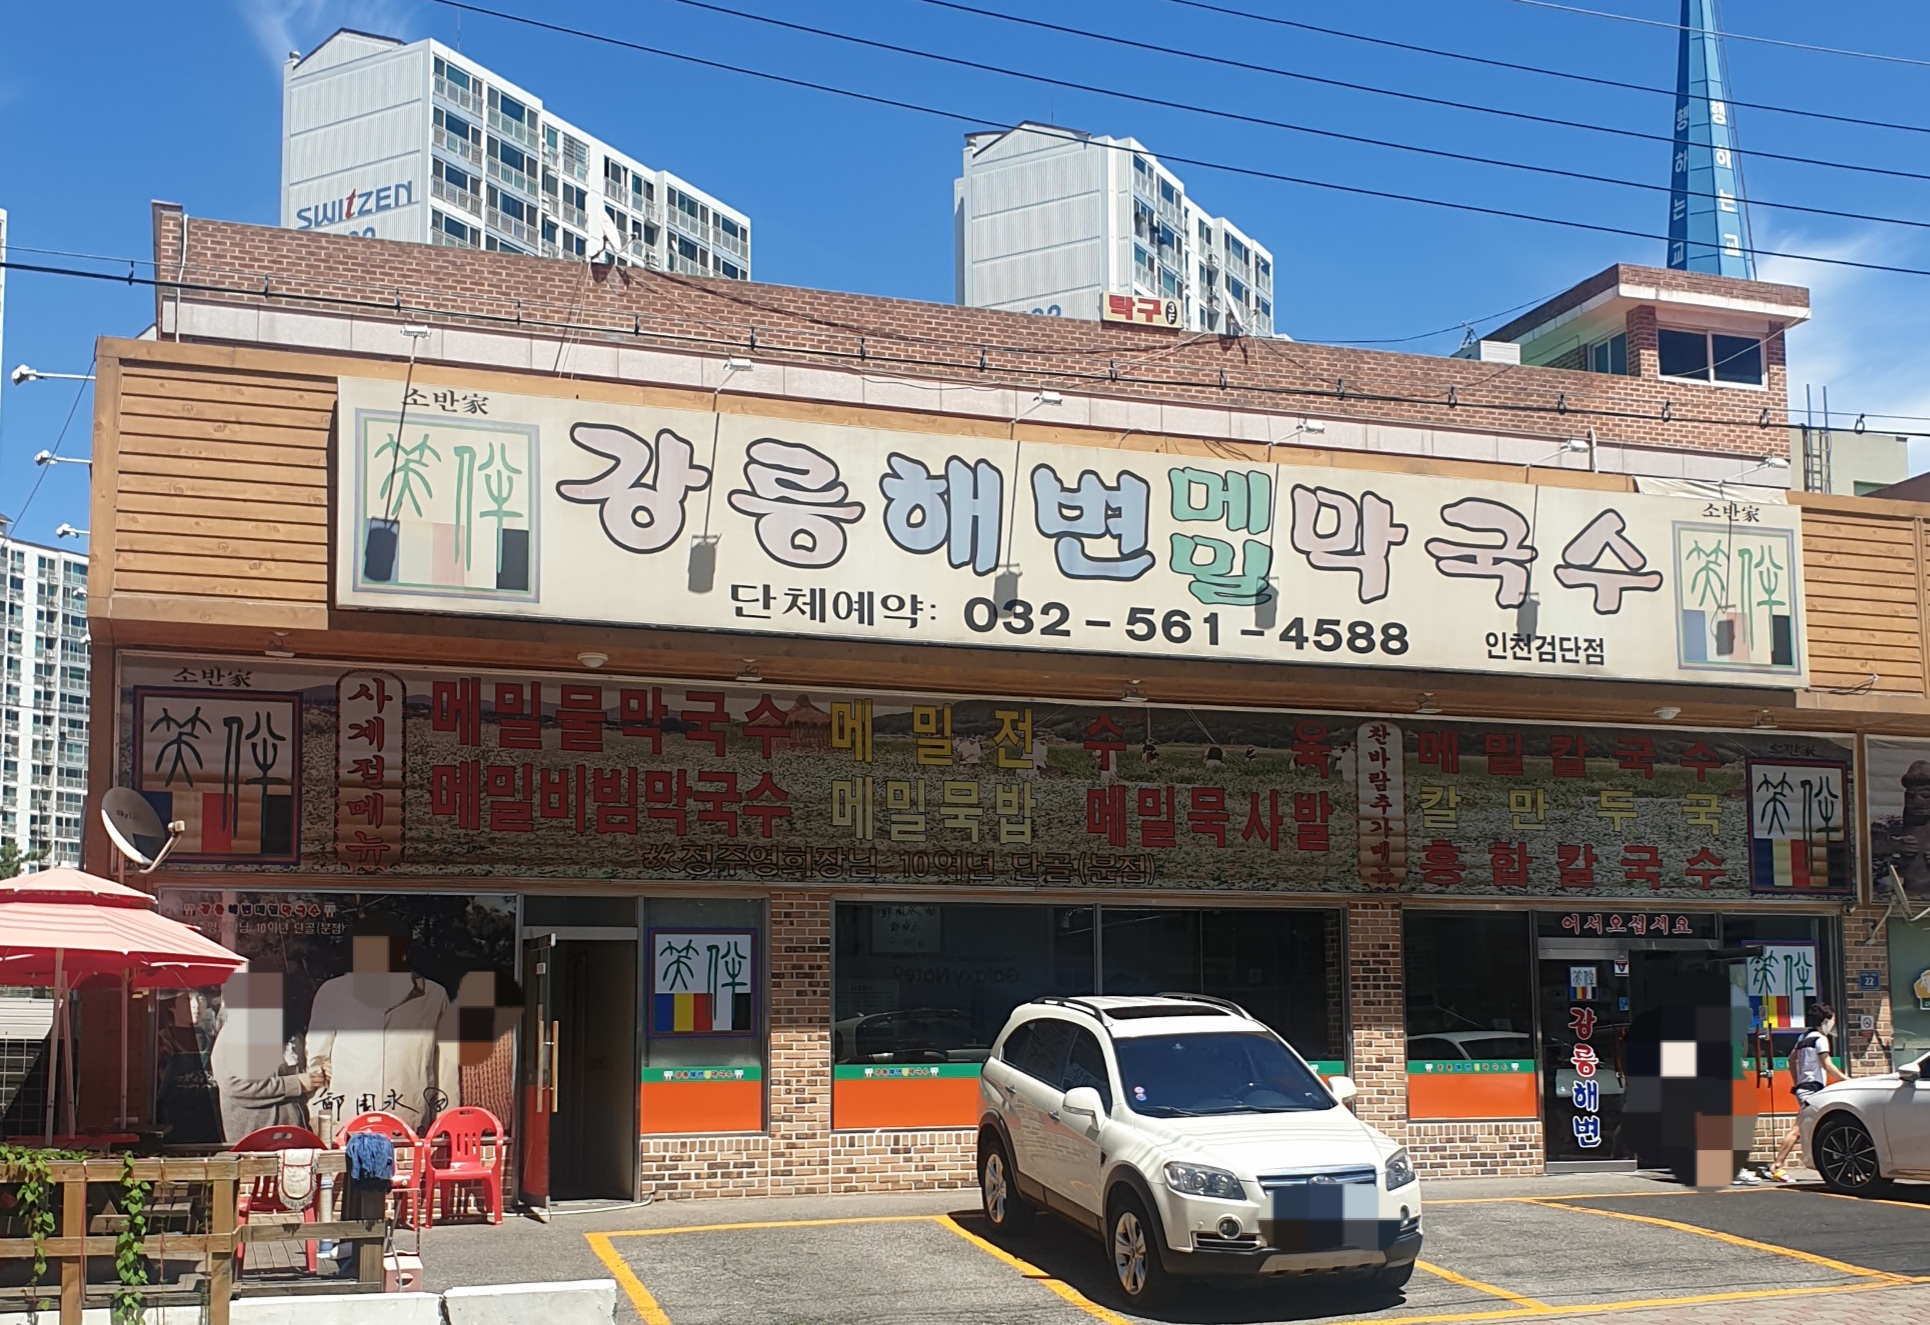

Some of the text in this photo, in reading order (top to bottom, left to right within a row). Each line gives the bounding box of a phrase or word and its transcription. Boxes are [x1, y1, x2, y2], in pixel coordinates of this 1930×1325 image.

[1108, 294, 1161, 323] 탁구
[1290, 482, 1664, 615] 막국수
[729, 582, 937, 630] 단체예약:
[1485, 630, 1606, 667] 인천검단점
[432, 677, 792, 760] 메밀물막국수
[346, 677, 395, 866] 사계절메뉴
[432, 761, 792, 838] 메밀비빔막국수
[1367, 722, 1395, 886] 찬바람추가메뉴
[830, 775, 1036, 844] 메밀묵밥
[1086, 784, 1333, 852] 메밀묵사발
[1561, 913, 1693, 935] 어서오십시요
[1864, 977, 1875, 985] 22
[1567, 1006, 1602, 1148] 강릉해변
